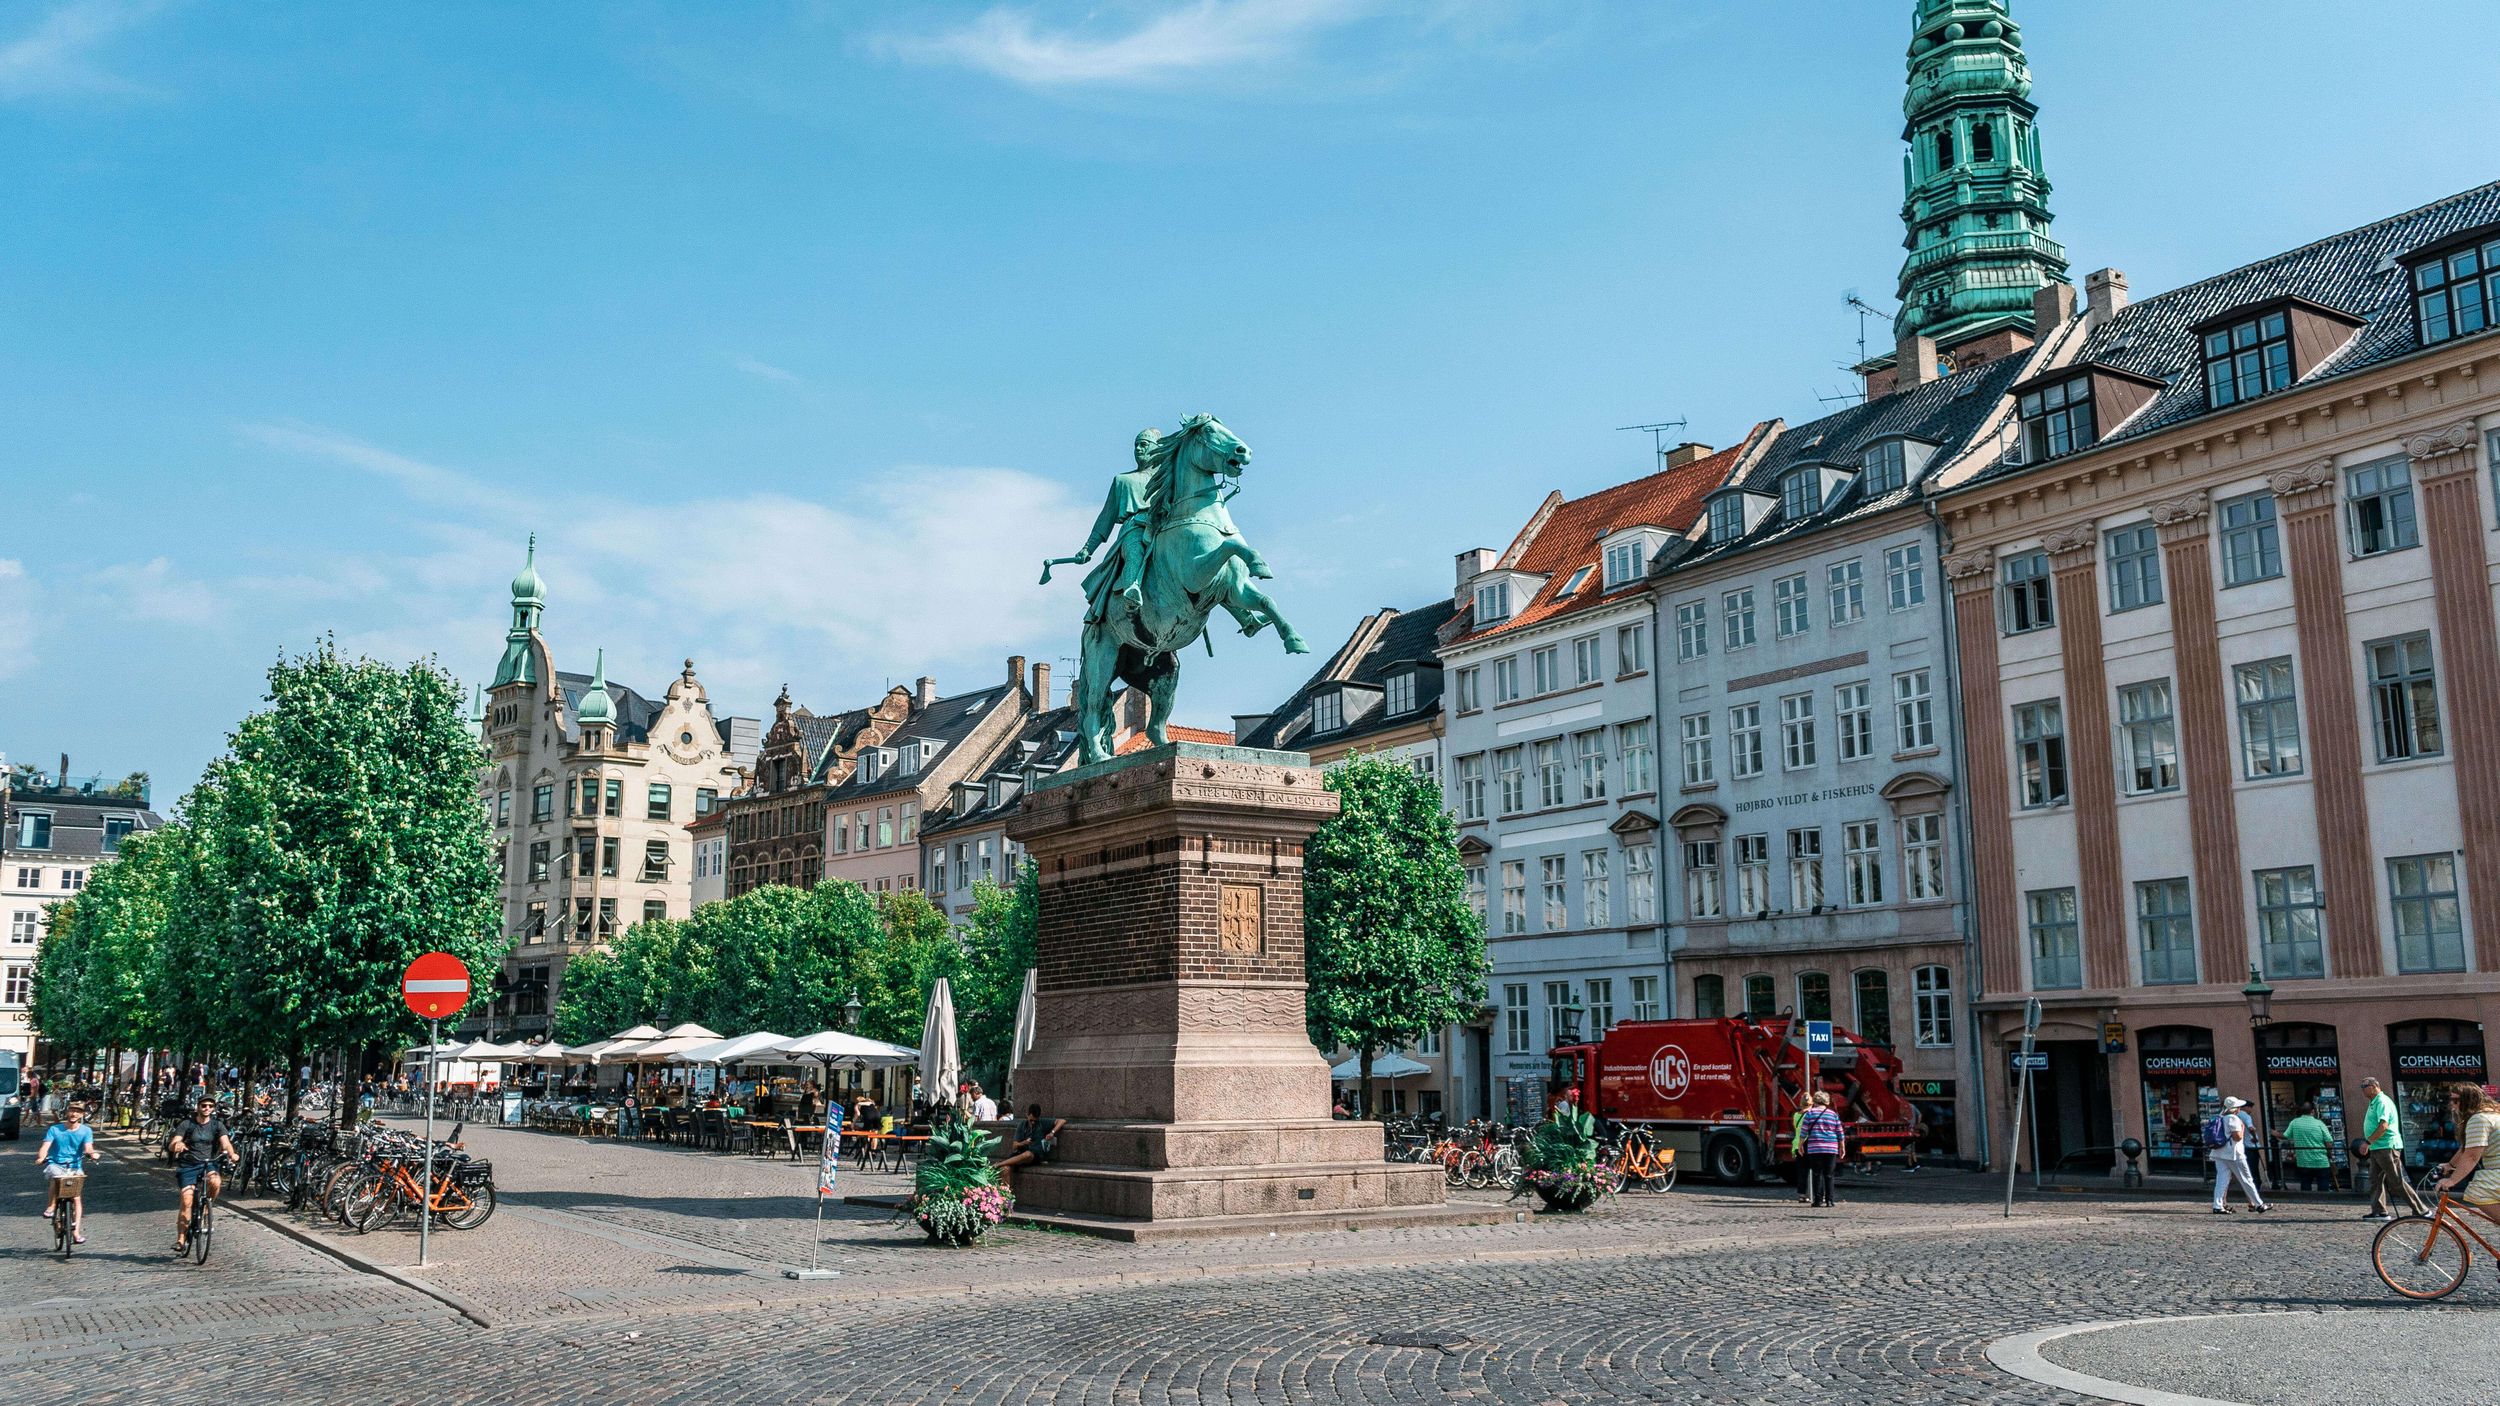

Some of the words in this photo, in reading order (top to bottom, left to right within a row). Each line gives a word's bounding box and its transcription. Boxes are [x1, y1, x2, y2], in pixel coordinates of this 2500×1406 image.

[1735, 798, 1774, 813] HØJBRO
[1776, 792, 1808, 807] VILDT
[1811, 791, 1820, 802] &
[1822, 783, 1876, 801] FISKEHUS
[1810, 1033, 1829, 1042] TAXI
[2145, 1057, 2212, 1068] COPENHAGEN
[2399, 1055, 2482, 1067] COPENHAGEN
[1654, 1055, 1687, 1090] HCS
[2187, 1067, 2212, 1077] design
[2300, 1067, 2308, 1075] &
[2309, 1067, 2337, 1077] design
[2441, 1066, 2449, 1074] &
[2450, 1066, 2482, 1076] design
[1902, 1082, 1927, 1095] WOK
